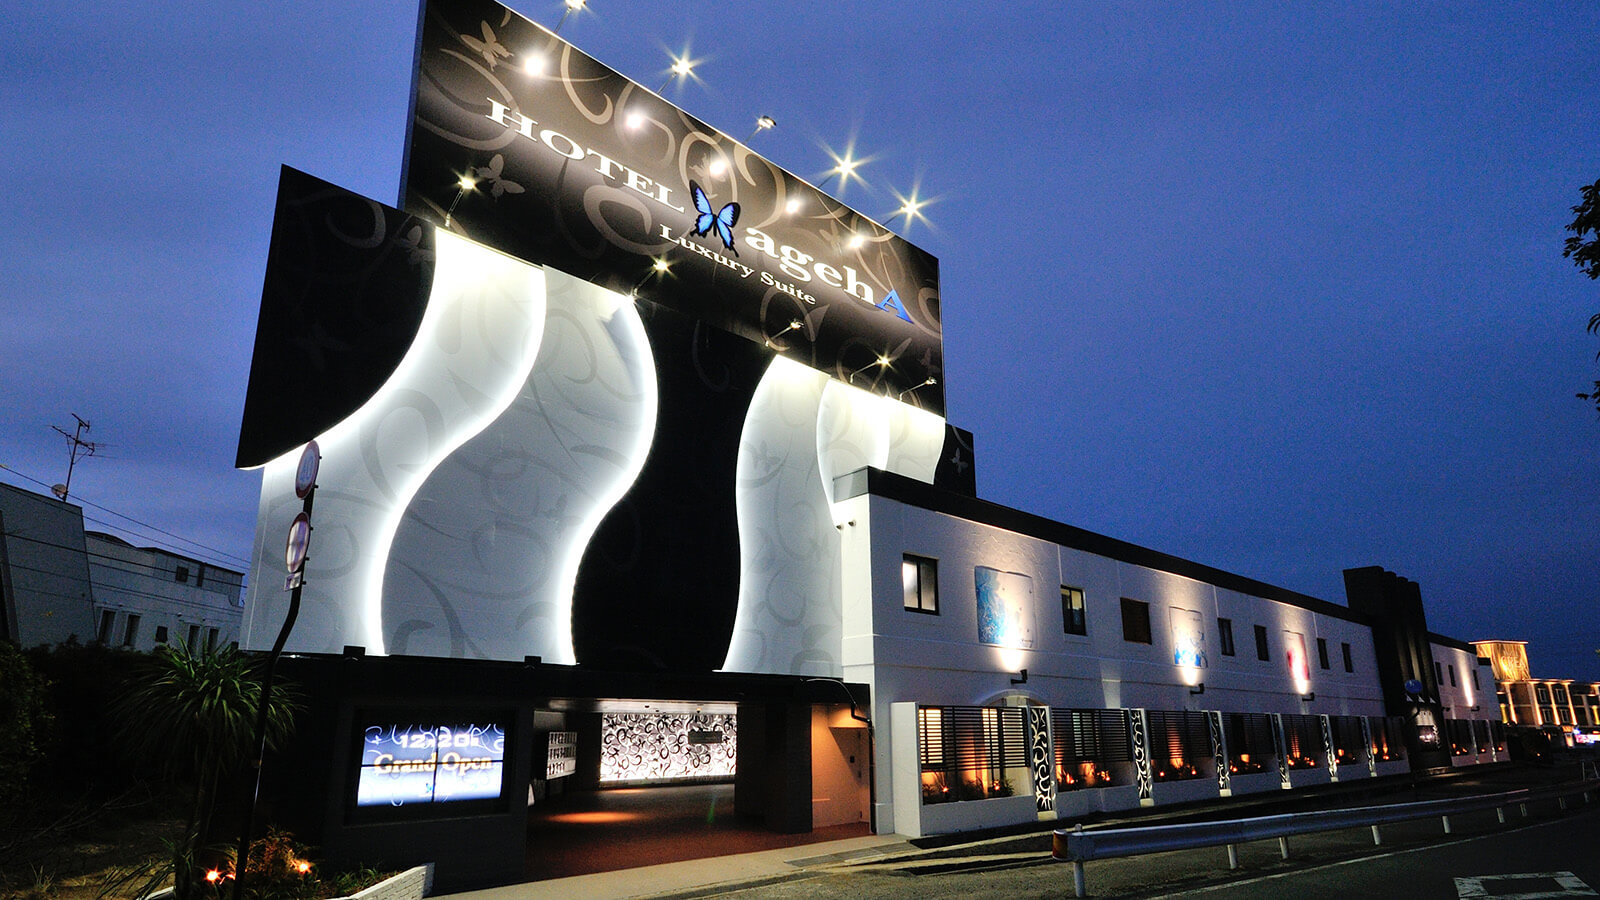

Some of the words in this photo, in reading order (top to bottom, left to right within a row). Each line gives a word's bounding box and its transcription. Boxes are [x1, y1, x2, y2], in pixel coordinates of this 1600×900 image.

[485, 97, 684, 213] HOTEL
[746, 226, 914, 324] agehA
[660, 224, 755, 279] Luxury
[761, 271, 816, 305] Suite
[374, 752, 436, 773] Grand
[442, 752, 492, 776] Open
